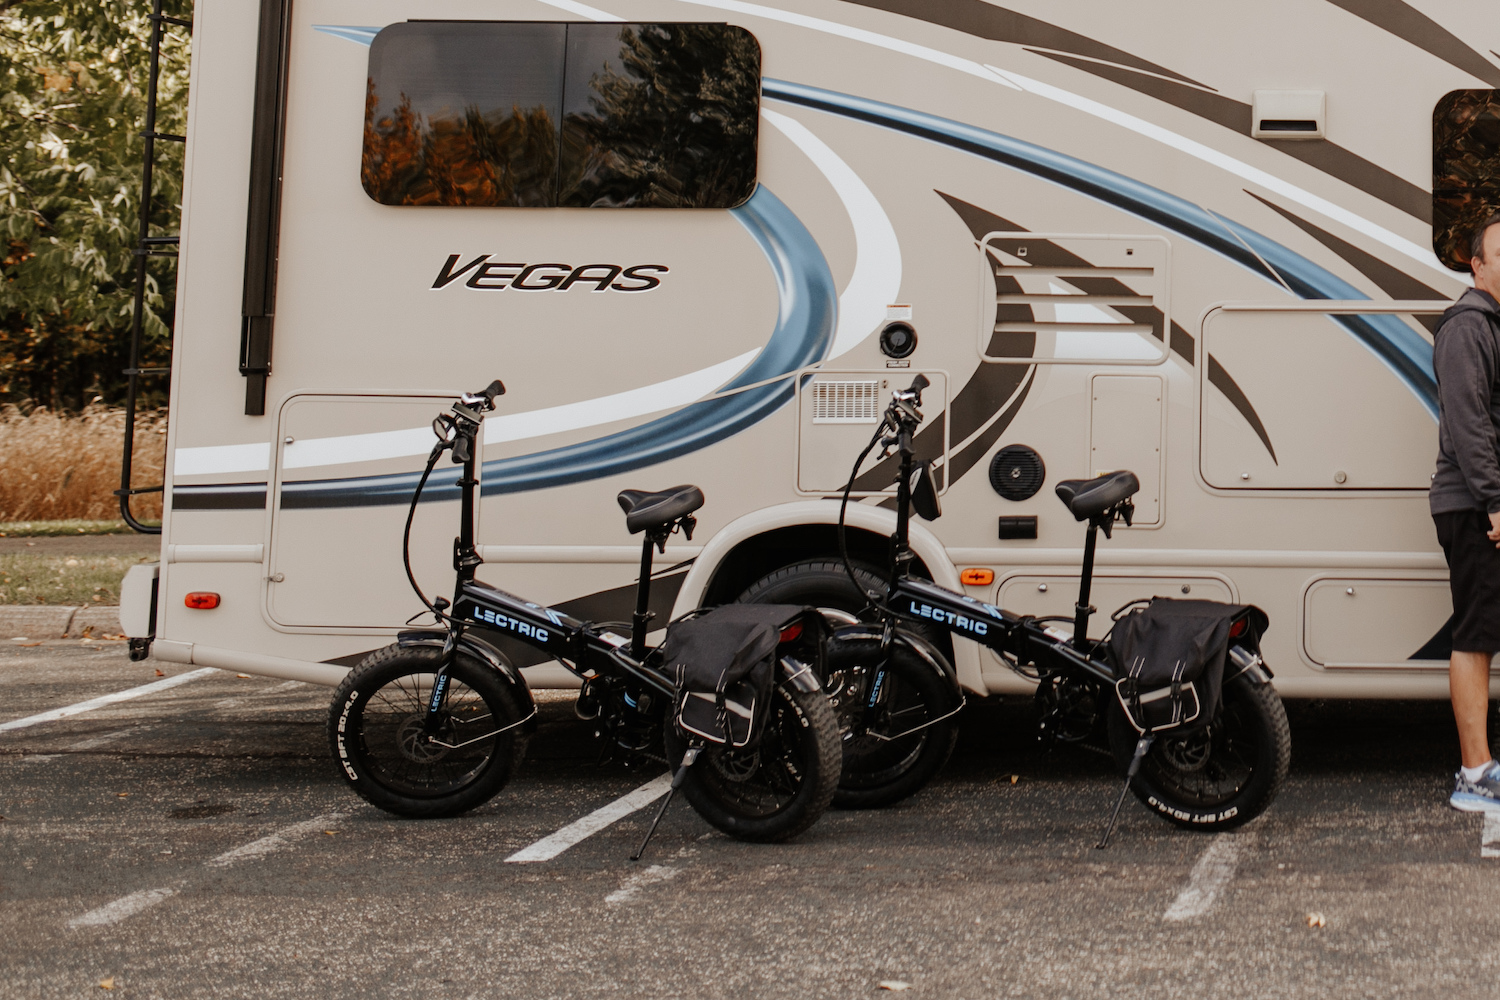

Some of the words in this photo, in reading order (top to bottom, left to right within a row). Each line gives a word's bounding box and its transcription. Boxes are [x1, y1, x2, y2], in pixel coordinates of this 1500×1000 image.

[429, 254, 670, 293] VEGAS
[474, 606, 548, 642] LECTRIC
[910, 601, 988, 635] LECTRIC
[431, 674, 447, 713] LECTRIC
[868, 671, 885, 707] LECTRIC
[338, 734, 347, 758] BFT
[342, 760, 358, 780] CST
[1192, 814, 1216, 823] BFT
[1218, 806, 1238, 821] CST
